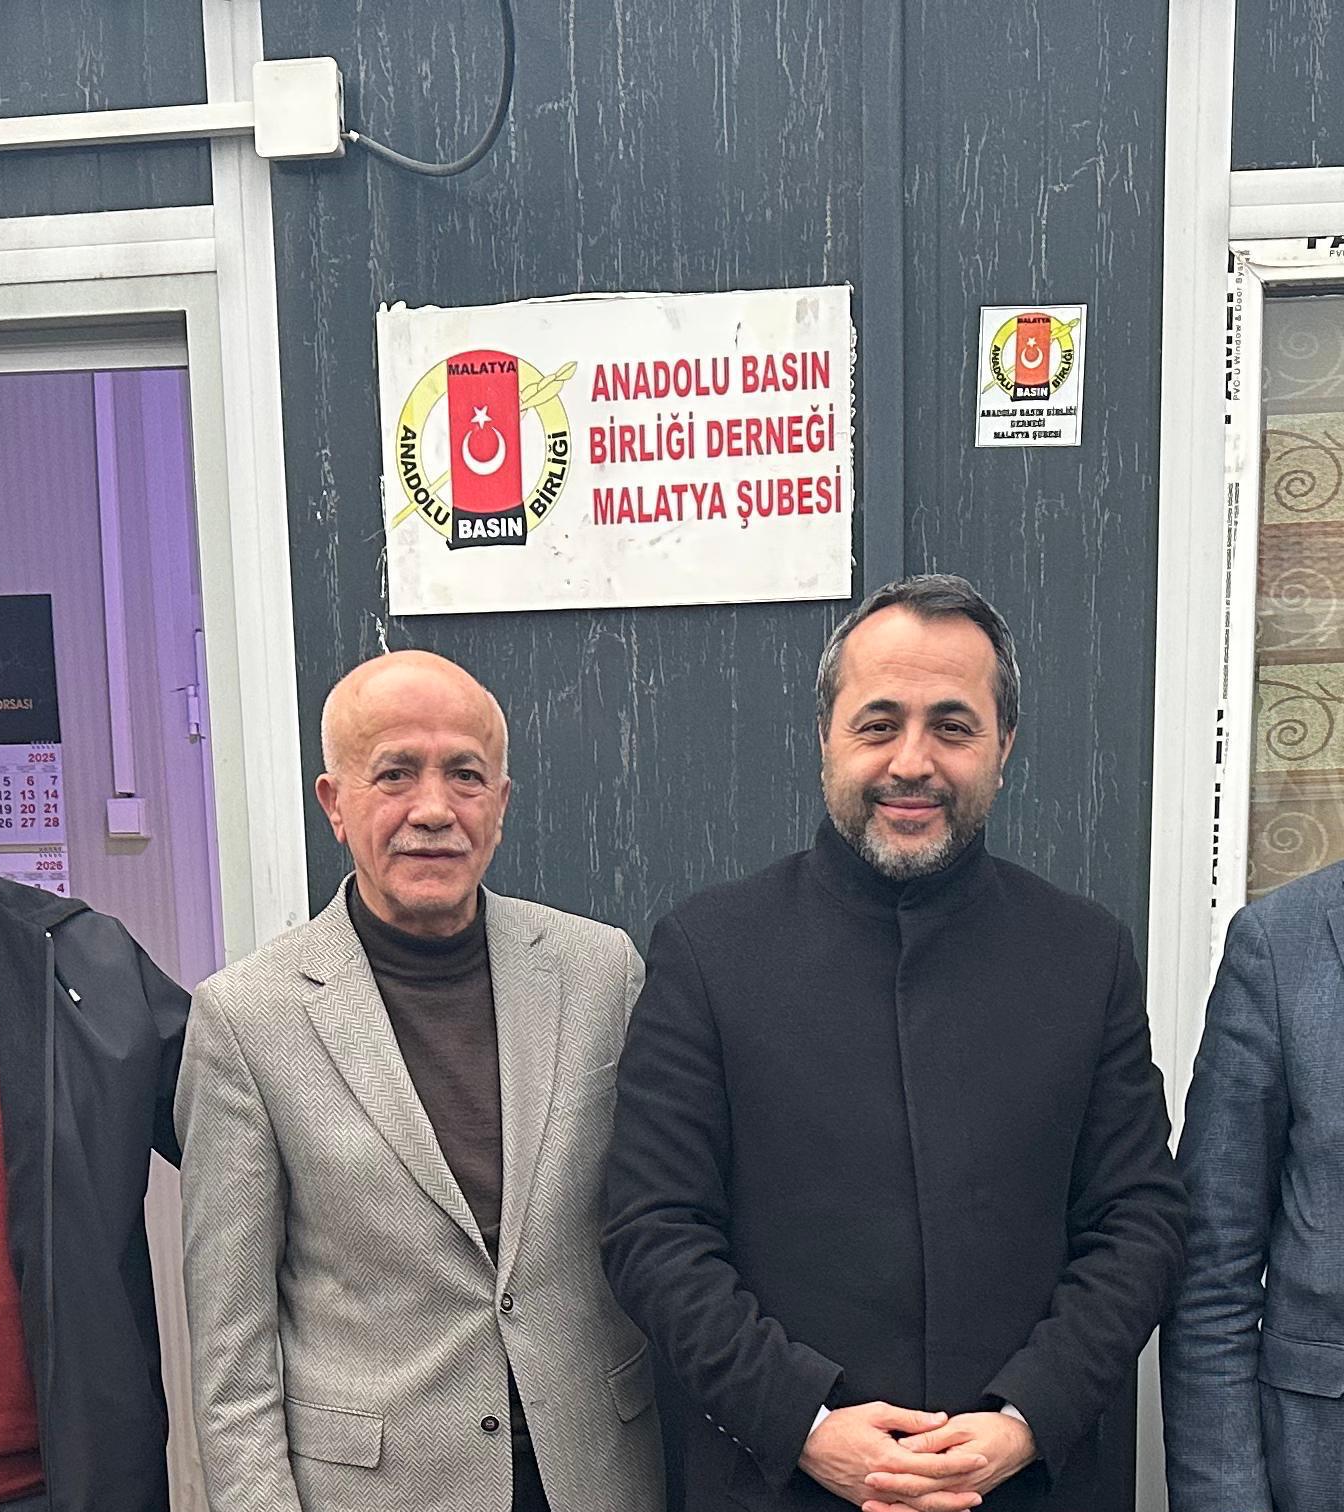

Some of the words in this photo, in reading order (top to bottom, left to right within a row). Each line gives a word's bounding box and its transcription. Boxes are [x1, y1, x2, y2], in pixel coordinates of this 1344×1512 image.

[448, 361, 517, 376] MALATYA
[992, 344, 1015, 391] ANADOLU
[591, 356, 730, 402] ANADOLU
[741, 351, 830, 394] BASIN
[1016, 387, 1048, 397] BASIN
[590, 411, 695, 465] BİRLİĞİ
[707, 403, 835, 458] DERNEĞİ
[400, 424, 450, 527] ANADOLU
[530, 430, 568, 519] BİRLİĞİ
[593, 482, 727, 526] MALATYA
[738, 466, 842, 530] ŞUBESİ
[458, 516, 523, 539] BASIN
[28, 752, 56, 763] 2025
[3, 776, 11, 786] 5
[27, 775, 34, 786] 6
[50, 775, 58, 785] 7
[20, 790, 35, 800] 13
[44, 789, 58, 799] 14
[20, 804, 35, 814] 20
[44, 803, 58, 813] 21
[21, 817, 36, 828] 27
[44, 817, 60, 827] 28
[36, 861, 63, 871] 2026
[57, 883, 64, 893] 4
